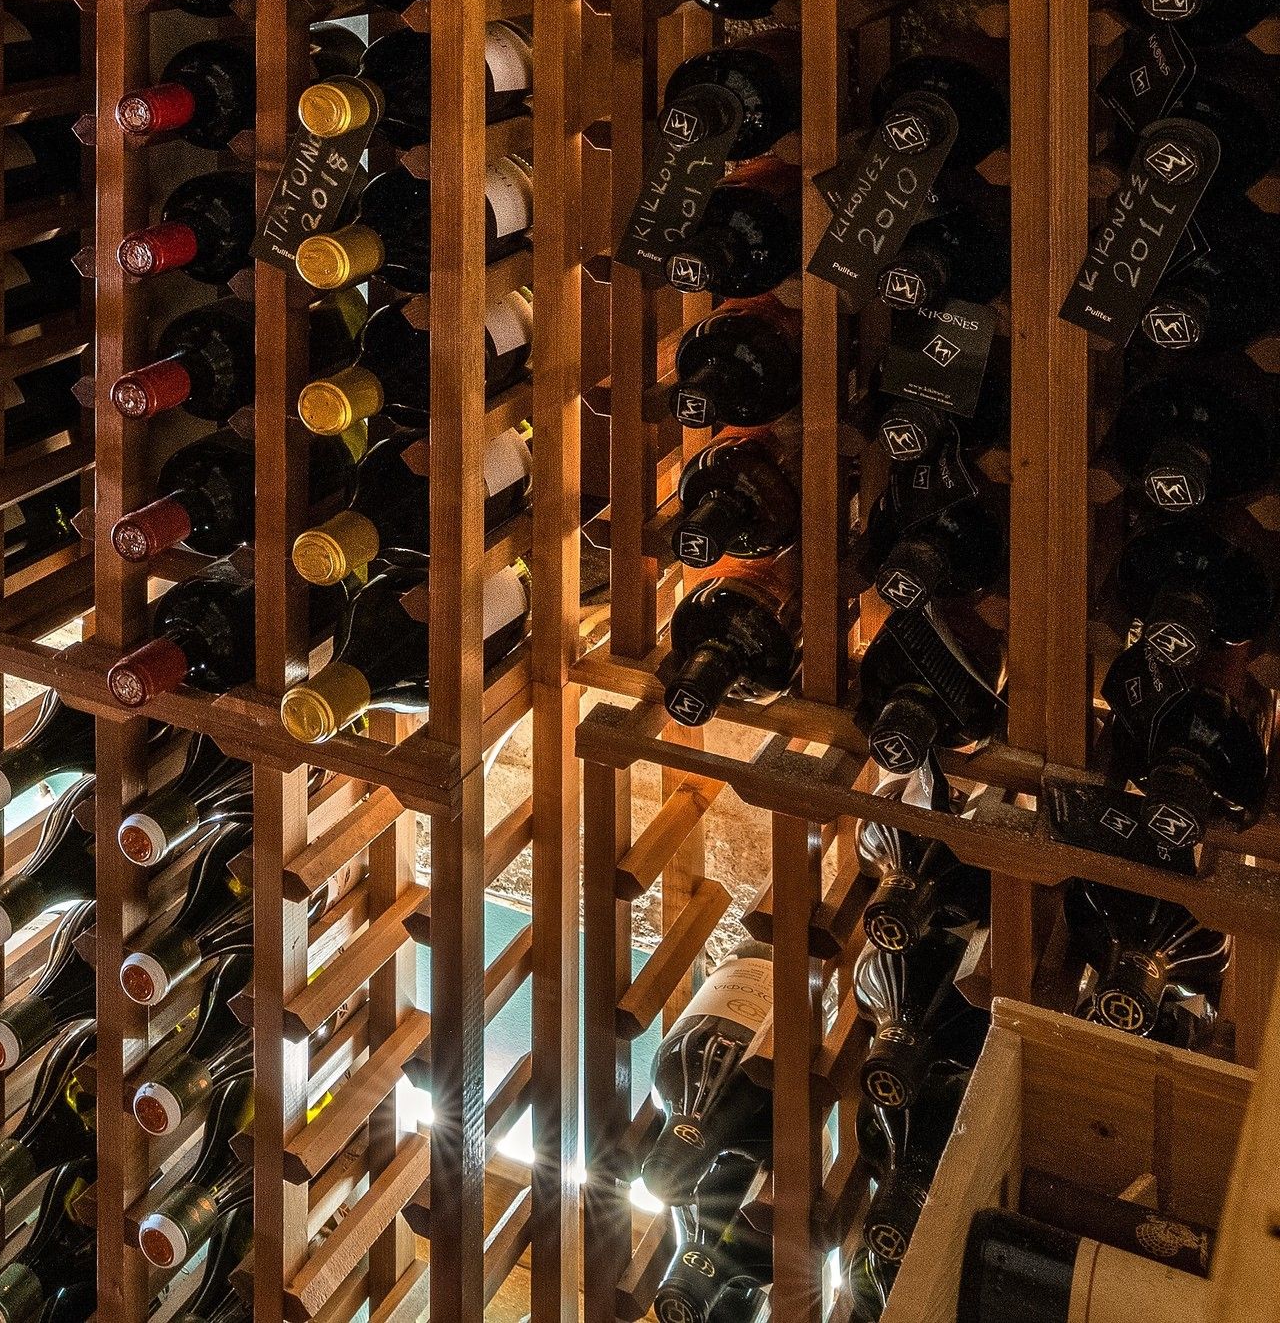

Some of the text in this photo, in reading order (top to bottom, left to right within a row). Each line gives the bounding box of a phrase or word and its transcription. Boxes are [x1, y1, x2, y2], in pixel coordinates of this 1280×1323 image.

[301, 152, 348, 231] 2018
[858, 167, 918, 254] 2010
[1112, 194, 1177, 288] 2011
[637, 249, 662, 262] Pulltex
[832, 261, 858, 278] Pulltex
[917, 307, 980, 331] KIKONES
[1085, 305, 1112, 322] Pulltex
